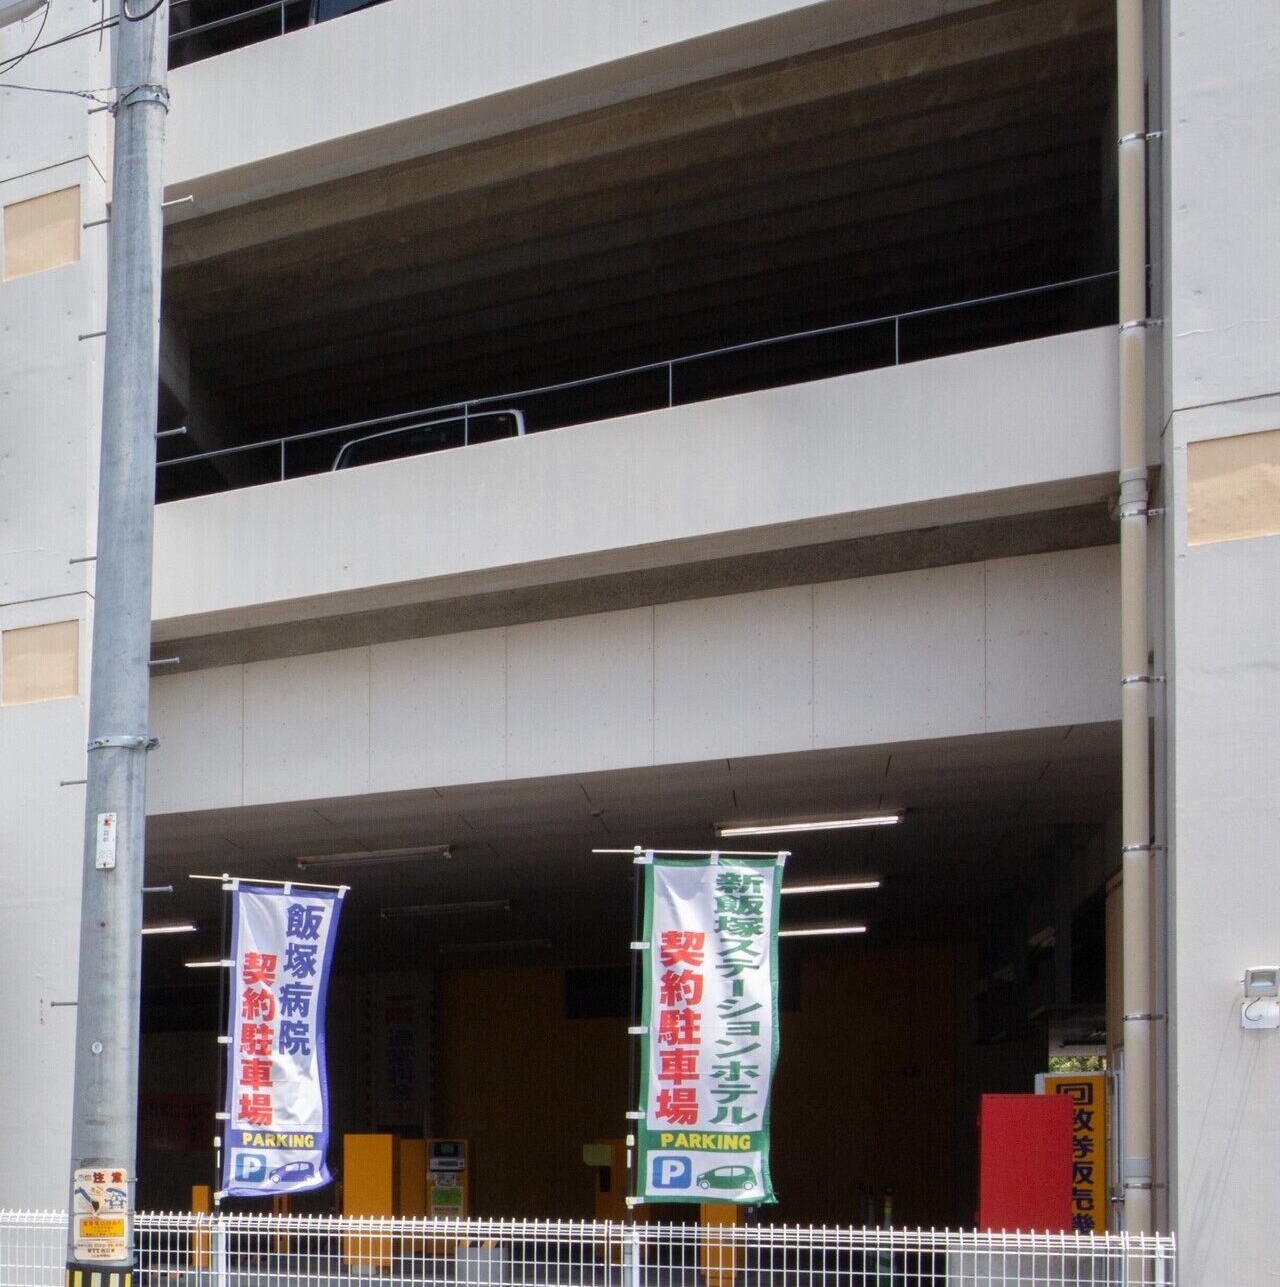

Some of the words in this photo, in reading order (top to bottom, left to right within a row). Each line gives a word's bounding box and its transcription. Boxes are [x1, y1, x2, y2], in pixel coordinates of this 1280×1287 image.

[278, 903, 326, 1056] 飯塚病院
[708, 871, 766, 1126] 新飯塚ステーションホテル
[238, 952, 277, 1127] 契約駐車場
[655, 930, 706, 1126] 契約駐車場
[242, 1132, 315, 1149] PARKING
[243, 1157, 264, 1178] P
[660, 1132, 752, 1150] PARKING
[661, 1160, 685, 1184] P
